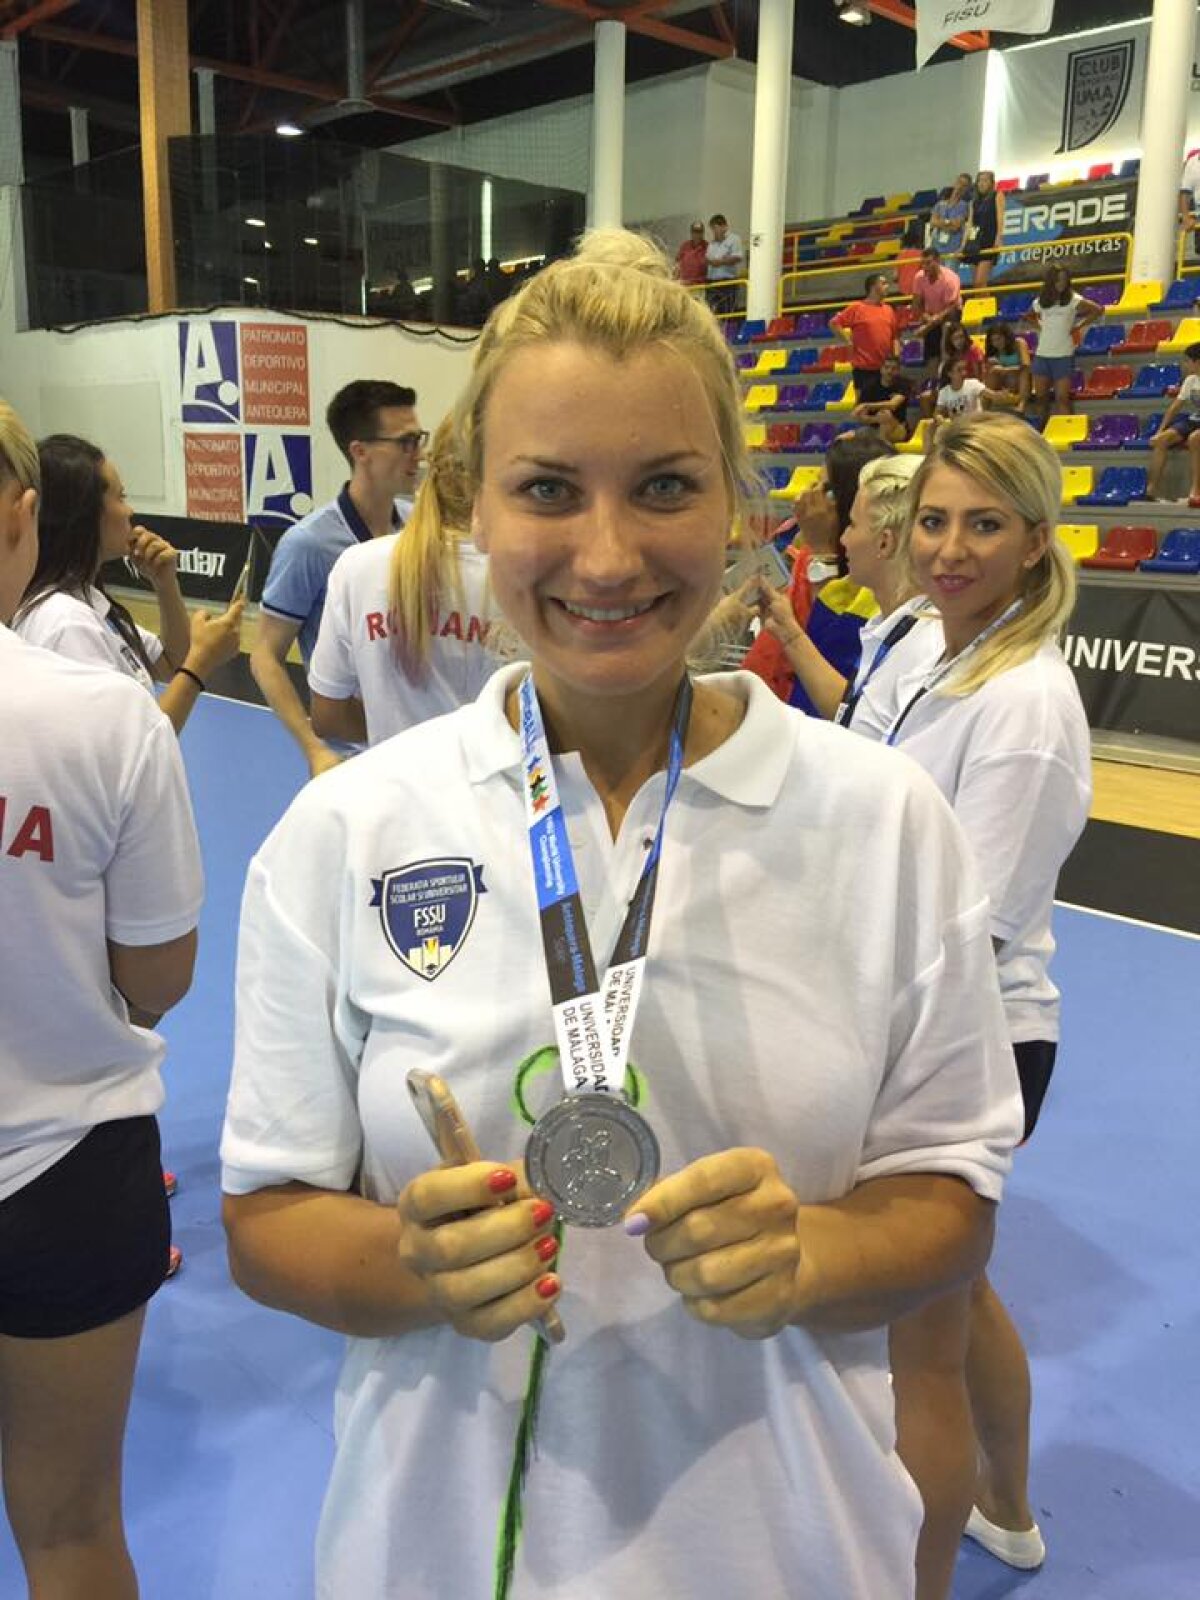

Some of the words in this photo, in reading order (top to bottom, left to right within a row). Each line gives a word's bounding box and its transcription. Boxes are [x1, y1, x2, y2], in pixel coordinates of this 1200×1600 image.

[944, 2, 990, 25] FISU
[1079, 54, 1121, 76] CLUB
[1076, 84, 1114, 105] UMA
[1003, 193, 1127, 235] ERADE
[1020, 237, 1121, 265] deportistas
[242, 329, 305, 345] PATRONATO
[244, 354, 306, 371] DEPORTIVO
[245, 379, 306, 396] MUNICIPAL
[246, 404, 307, 420] ANTEQUERA
[186, 439, 239, 452] PATRONATO
[187, 464, 240, 477] DEPORTIVO
[188, 487, 240, 501] MUNICIPAL
[414, 903, 446, 928] FSSU
[609, 969, 623, 988] DE
[562, 1006, 579, 1026] DE
